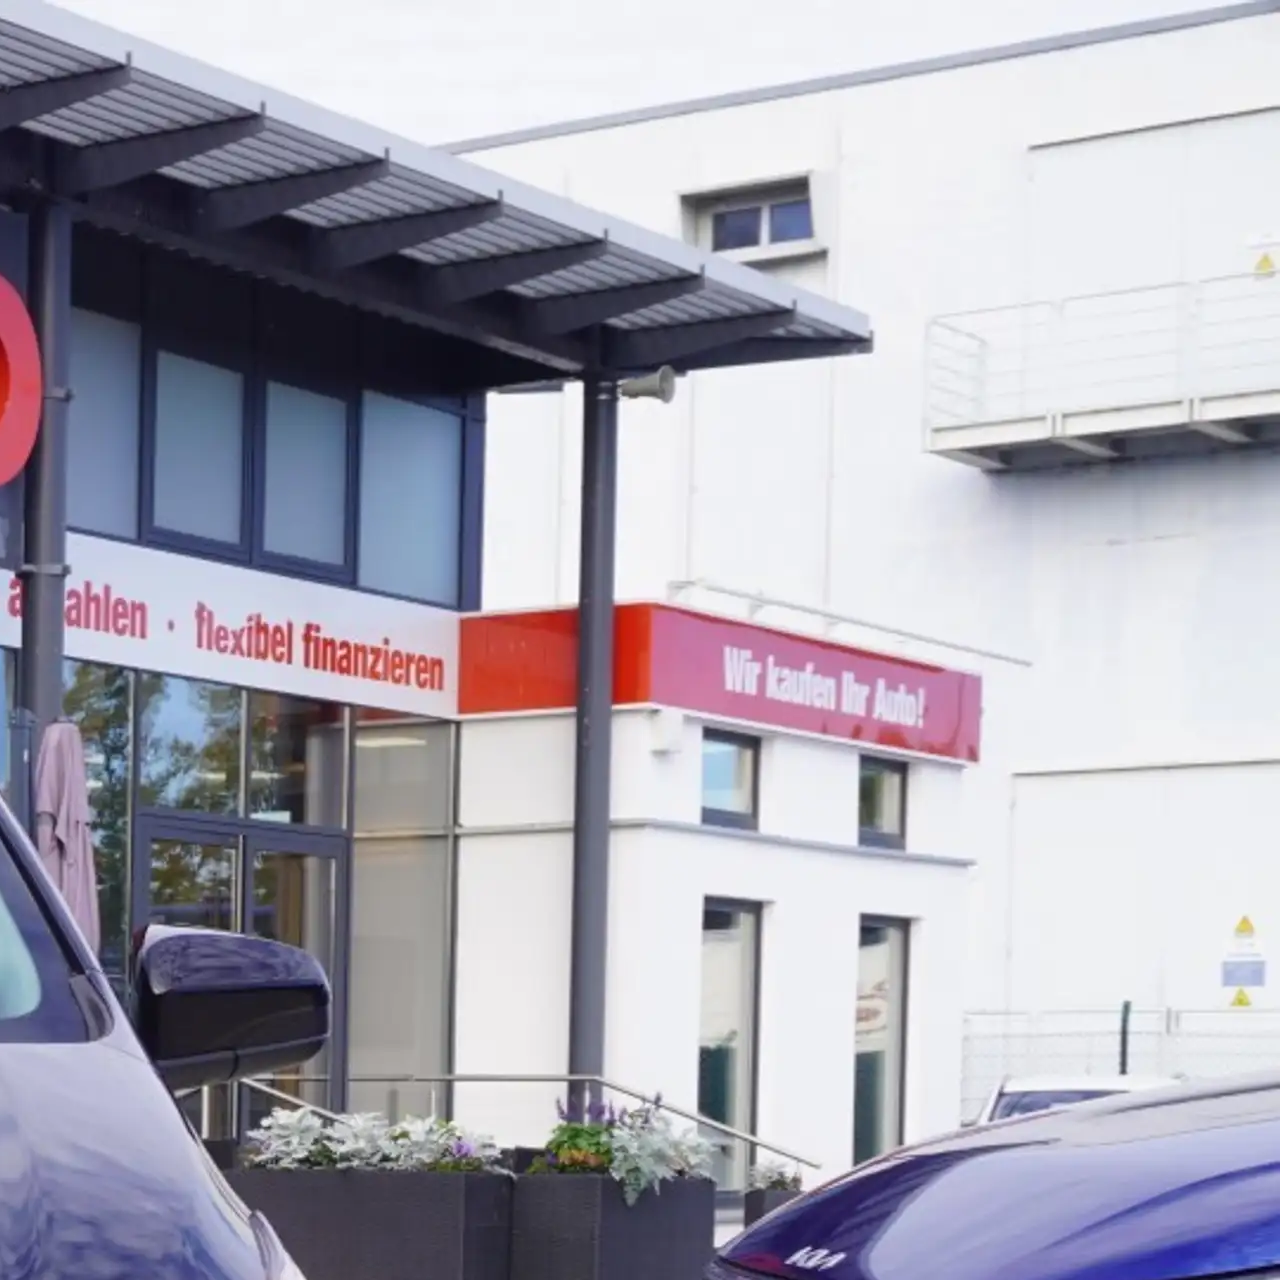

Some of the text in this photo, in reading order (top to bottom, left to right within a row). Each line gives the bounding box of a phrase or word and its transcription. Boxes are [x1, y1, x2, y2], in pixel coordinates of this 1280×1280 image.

[7, 577, 148, 640] aahlen
[195, 602, 293, 666] flexibel
[302, 622, 444, 691] finanzieren
[723, 646, 925, 728] Wir kaufen Ihr Auto!
